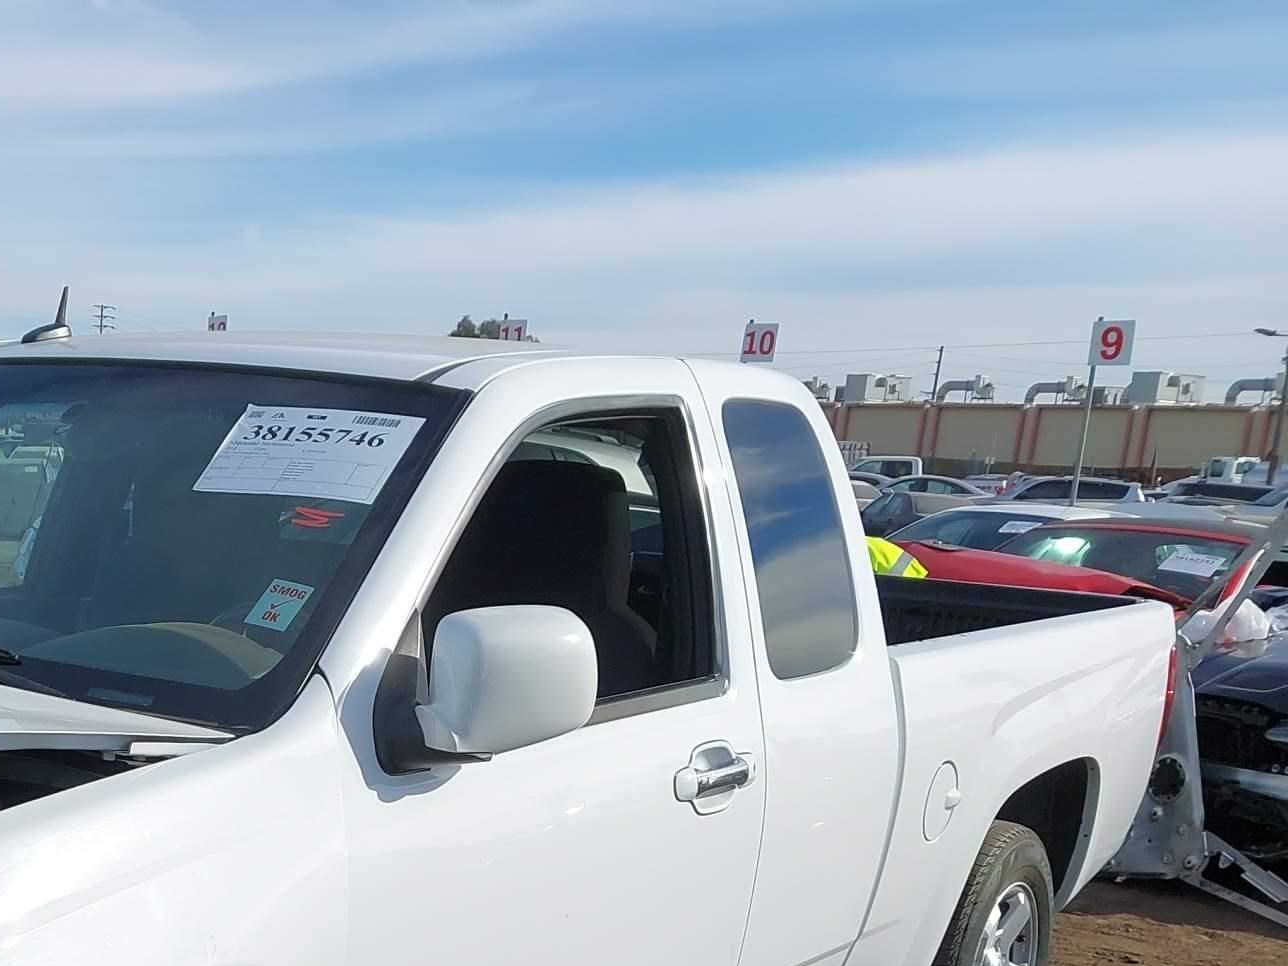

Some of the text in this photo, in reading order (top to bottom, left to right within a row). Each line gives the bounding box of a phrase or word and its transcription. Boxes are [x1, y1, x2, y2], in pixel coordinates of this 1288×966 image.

[743, 330, 775, 355] 10
[1100, 325, 1124, 361] 9
[242, 424, 390, 448] 38155746
[270, 584, 307, 600] SMOG
[262, 610, 281, 623] OK
